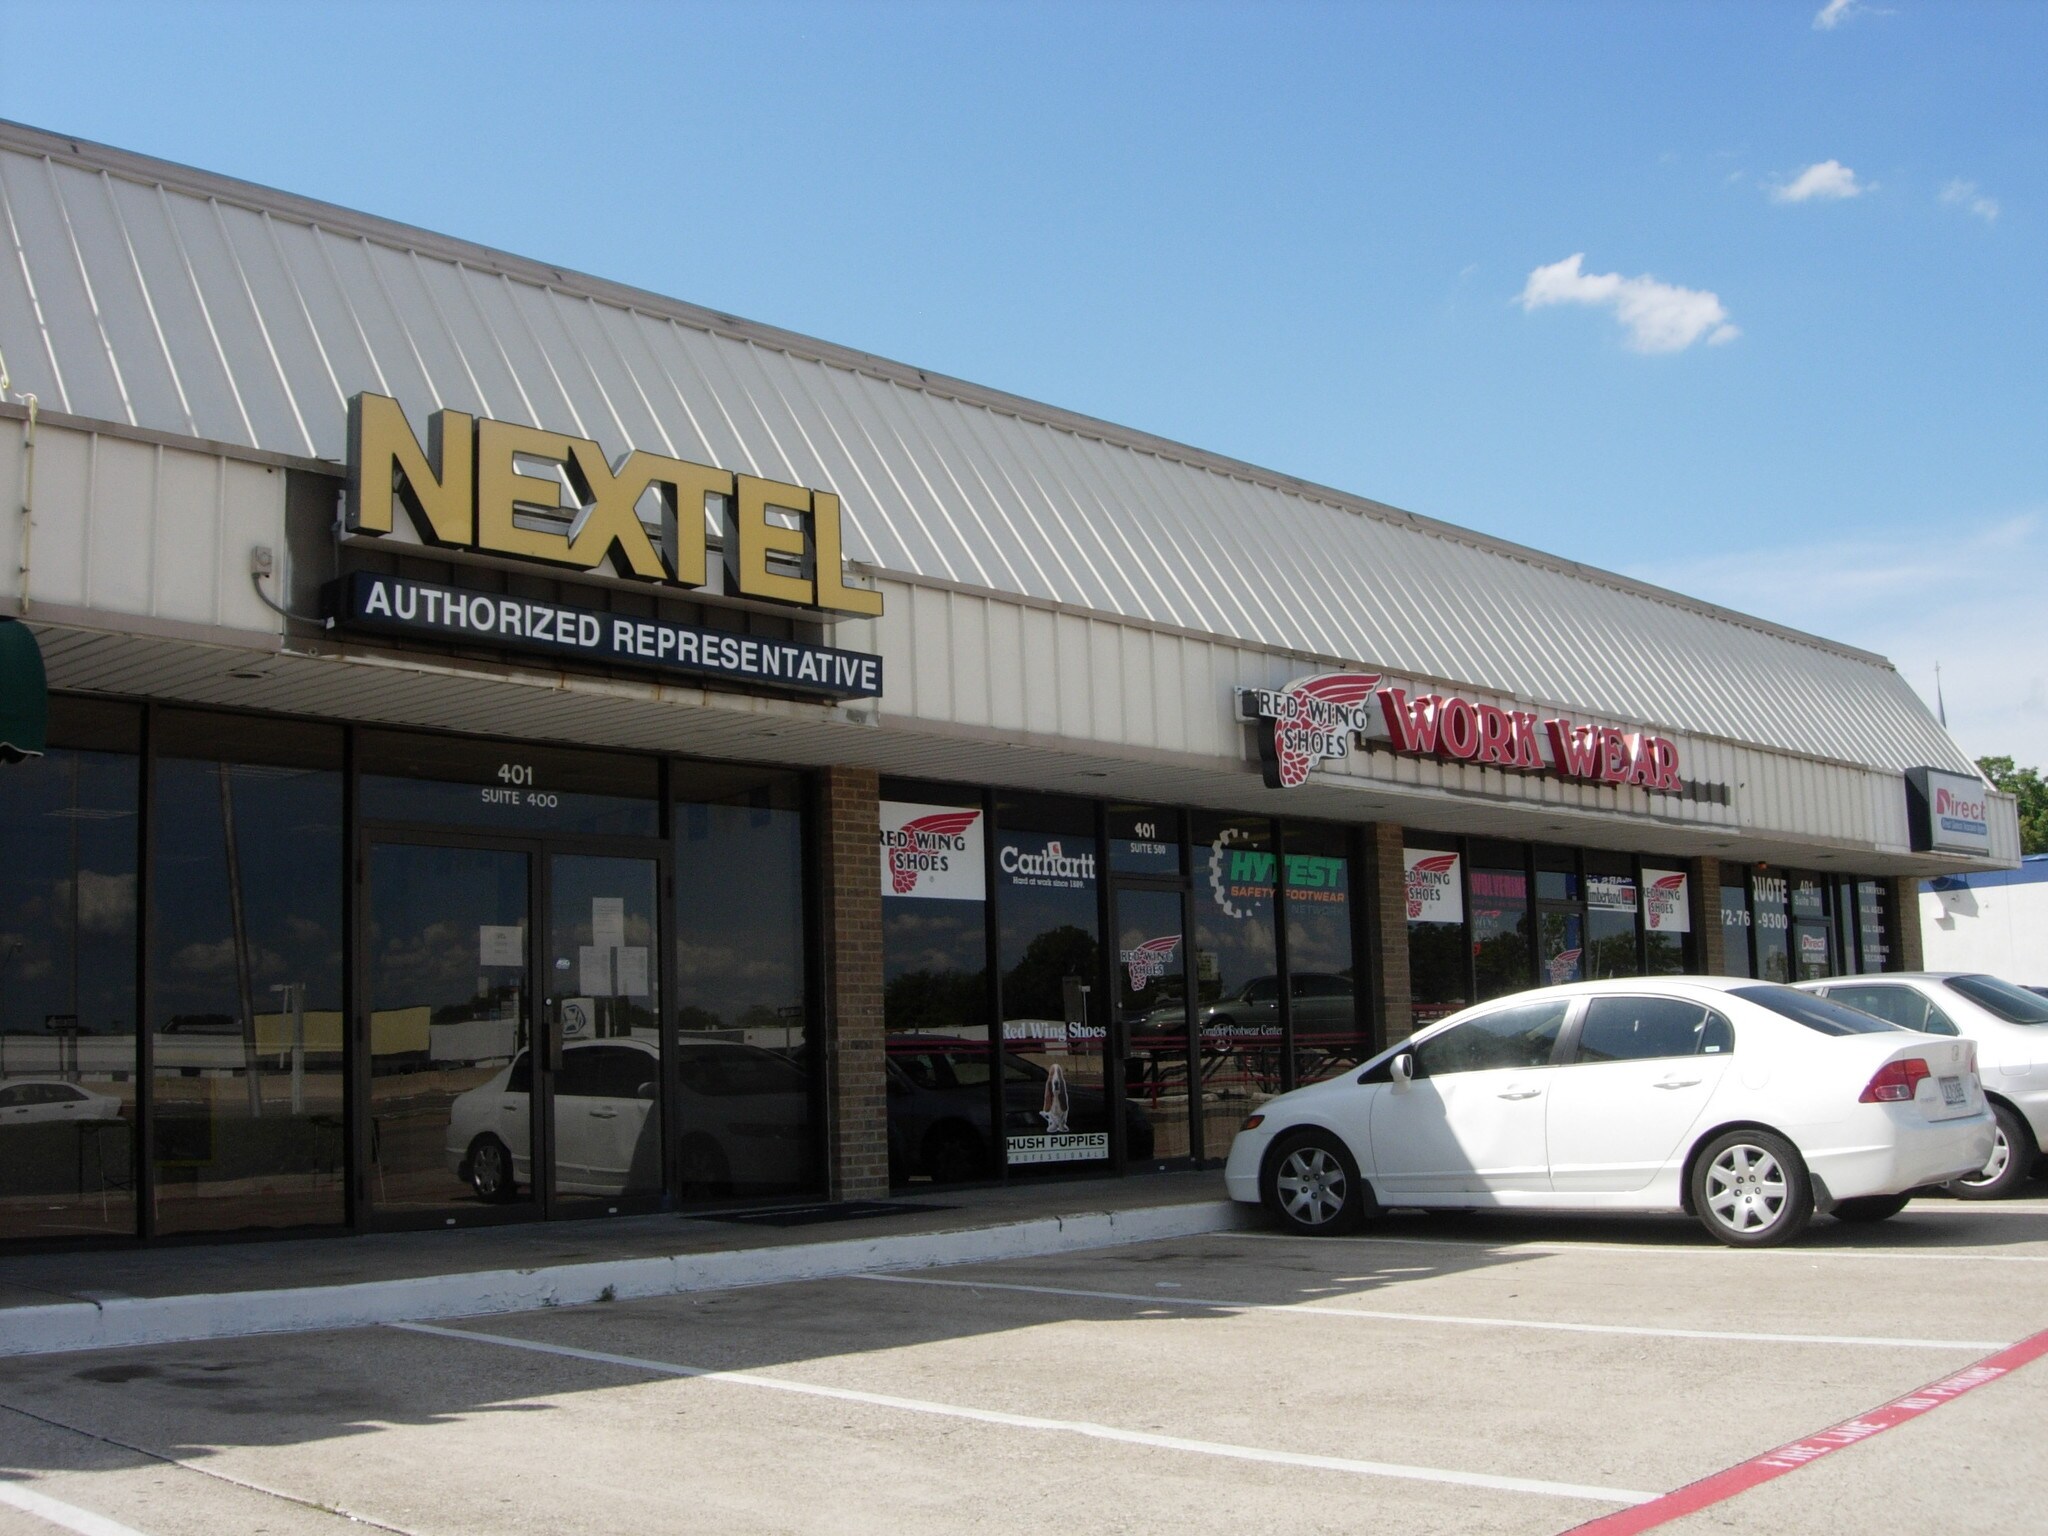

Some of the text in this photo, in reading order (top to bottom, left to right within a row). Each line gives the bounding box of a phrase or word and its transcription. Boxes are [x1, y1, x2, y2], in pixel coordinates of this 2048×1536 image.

[350, 391, 884, 617] NEXTEL
[365, 581, 877, 691] AUTHORIZED REPRESENTATIVE
[1259, 691, 1366, 729] RED WING
[1284, 728, 1346, 757] SHOES
[1377, 687, 1683, 791] WORK WEAR
[497, 763, 533, 787] 401
[480, 787, 559, 808] SUITE 400
[1936, 788, 1986, 820] Direct
[1134, 822, 1156, 839] 401
[879, 830, 966, 852] RED WING
[1130, 842, 1153, 855] SUITE
[896, 853, 949, 873] SHOES
[1000, 845, 1096, 879] Carhartt
[1012, 876, 1029, 885] Hard
[1036, 879, 1052, 887] work
[1420, 871, 1450, 885] WING
[1230, 886, 1277, 898] SAFETY
[1409, 887, 1440, 901] SHOES
[1658, 889, 1681, 900] WING
[1799, 880, 1814, 894] 401
[1650, 902, 1674, 914] SHOES
[1121, 951, 1140, 961] RED
[1133, 965, 1164, 976] SHOES
[1003, 1022, 1107, 1042] Red Wing Shoes
[1229, 1025, 1260, 1036] Footwear
[1260, 1025, 1283, 1036] Center
[1007, 1135, 1105, 1150] HUSH PUPPIES
[1007, 1150, 1106, 1163] PROFESSIONALS
[1759, 1444, 1832, 1467] FIRE
[1890, 1397, 1939, 1410] NO
